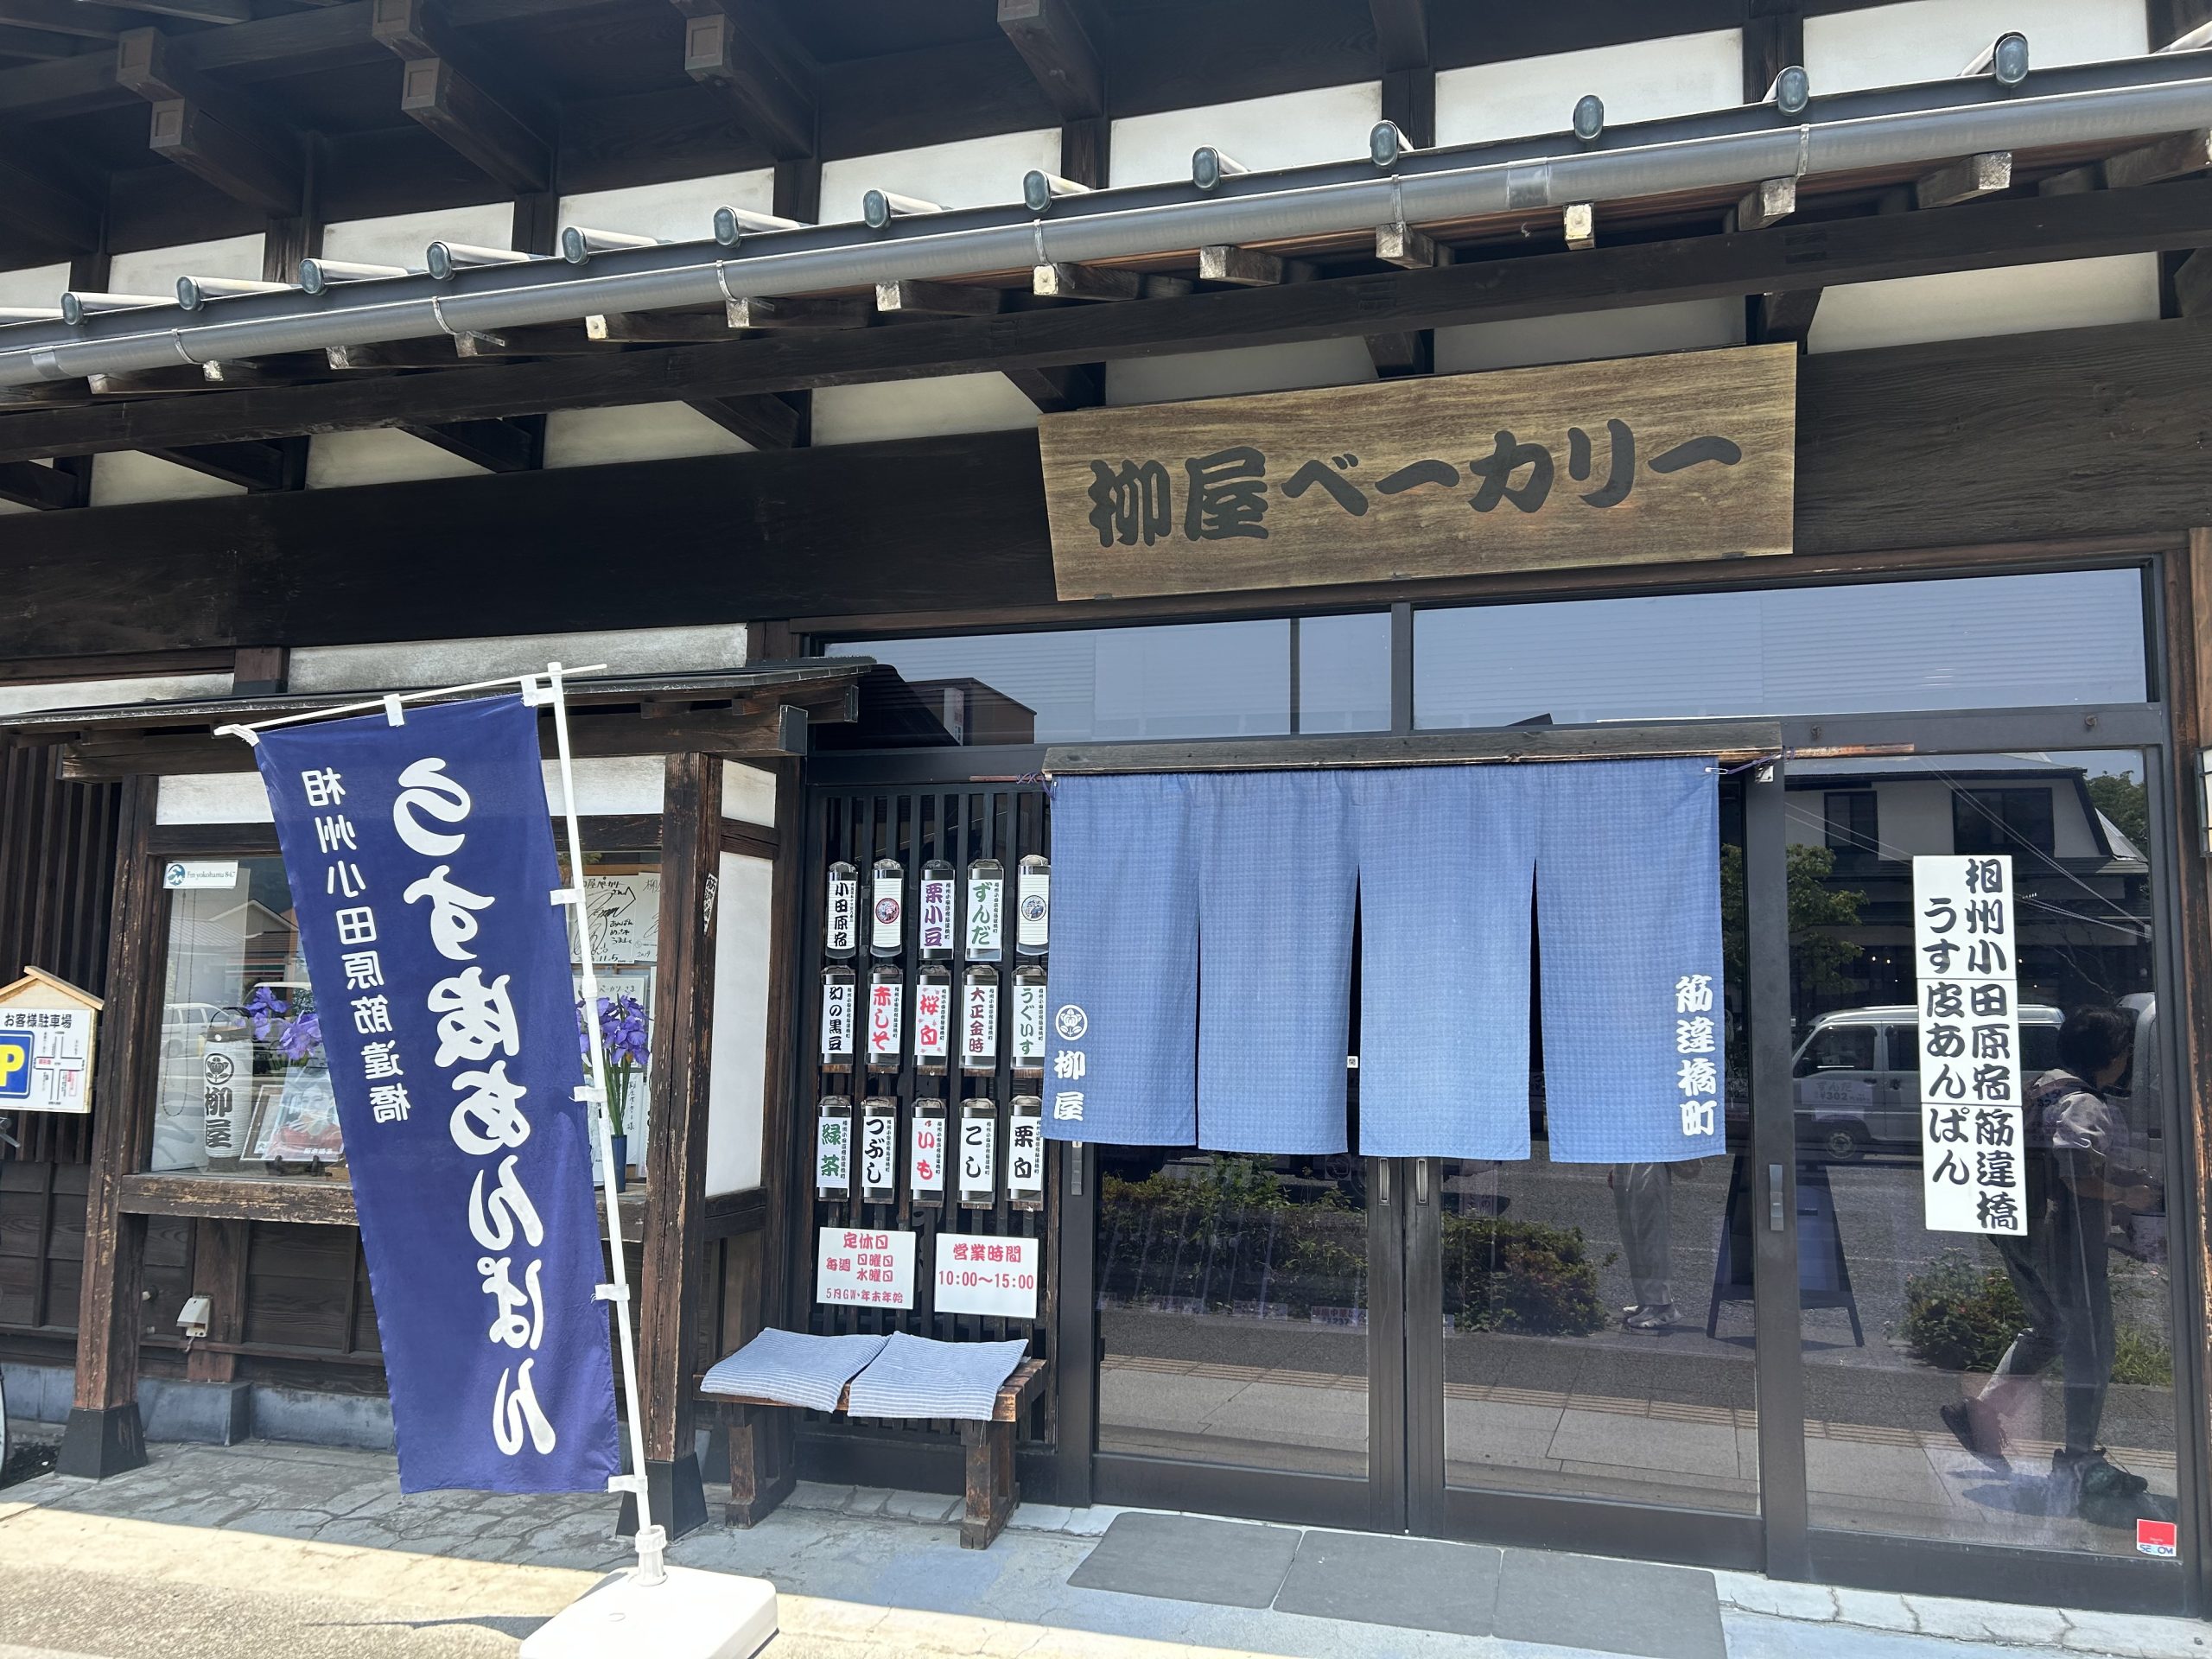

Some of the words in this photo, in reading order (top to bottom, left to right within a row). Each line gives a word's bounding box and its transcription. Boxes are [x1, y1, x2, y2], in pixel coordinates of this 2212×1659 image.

[1088, 418, 1742, 547] 柳屋ベーカリー
[835, 882, 849, 947] 小田原宿
[924, 883, 943, 946] 栗小豆
[971, 882, 992, 944] ずんだ
[4, 1014, 72, 1028] お客様駐車場
[829, 986, 843, 1052] 幻の黒豆
[872, 986, 891, 1051] 赤しそ
[969, 987, 985, 1052] 大正金時
[1020, 988, 1034, 1054] うぐいす
[1923, 898, 1970, 1185] うす皮あんぱん
[1965, 859, 2018, 1230] 相州小田原宿筋違橋
[0, 1045, 25, 1086] P
[1053, 1050, 1086, 1121] 柳屋
[1675, 975, 1717, 1135] 筋違橋町
[205, 1086, 232, 1148] 柳屋
[821, 1123, 841, 1176] 緑茶
[864, 1119, 885, 1183] つぶし
[917, 1131, 935, 1180] いも
[965, 1126, 982, 1178] こし
[826, 1257, 851, 1272] 毎週
[843, 1231, 888, 1249] 定休日
[857, 1254, 893, 1268] 日曜日
[953, 1243, 1021, 1262] 営業時間
[856, 1268, 893, 1282] 水曜日
